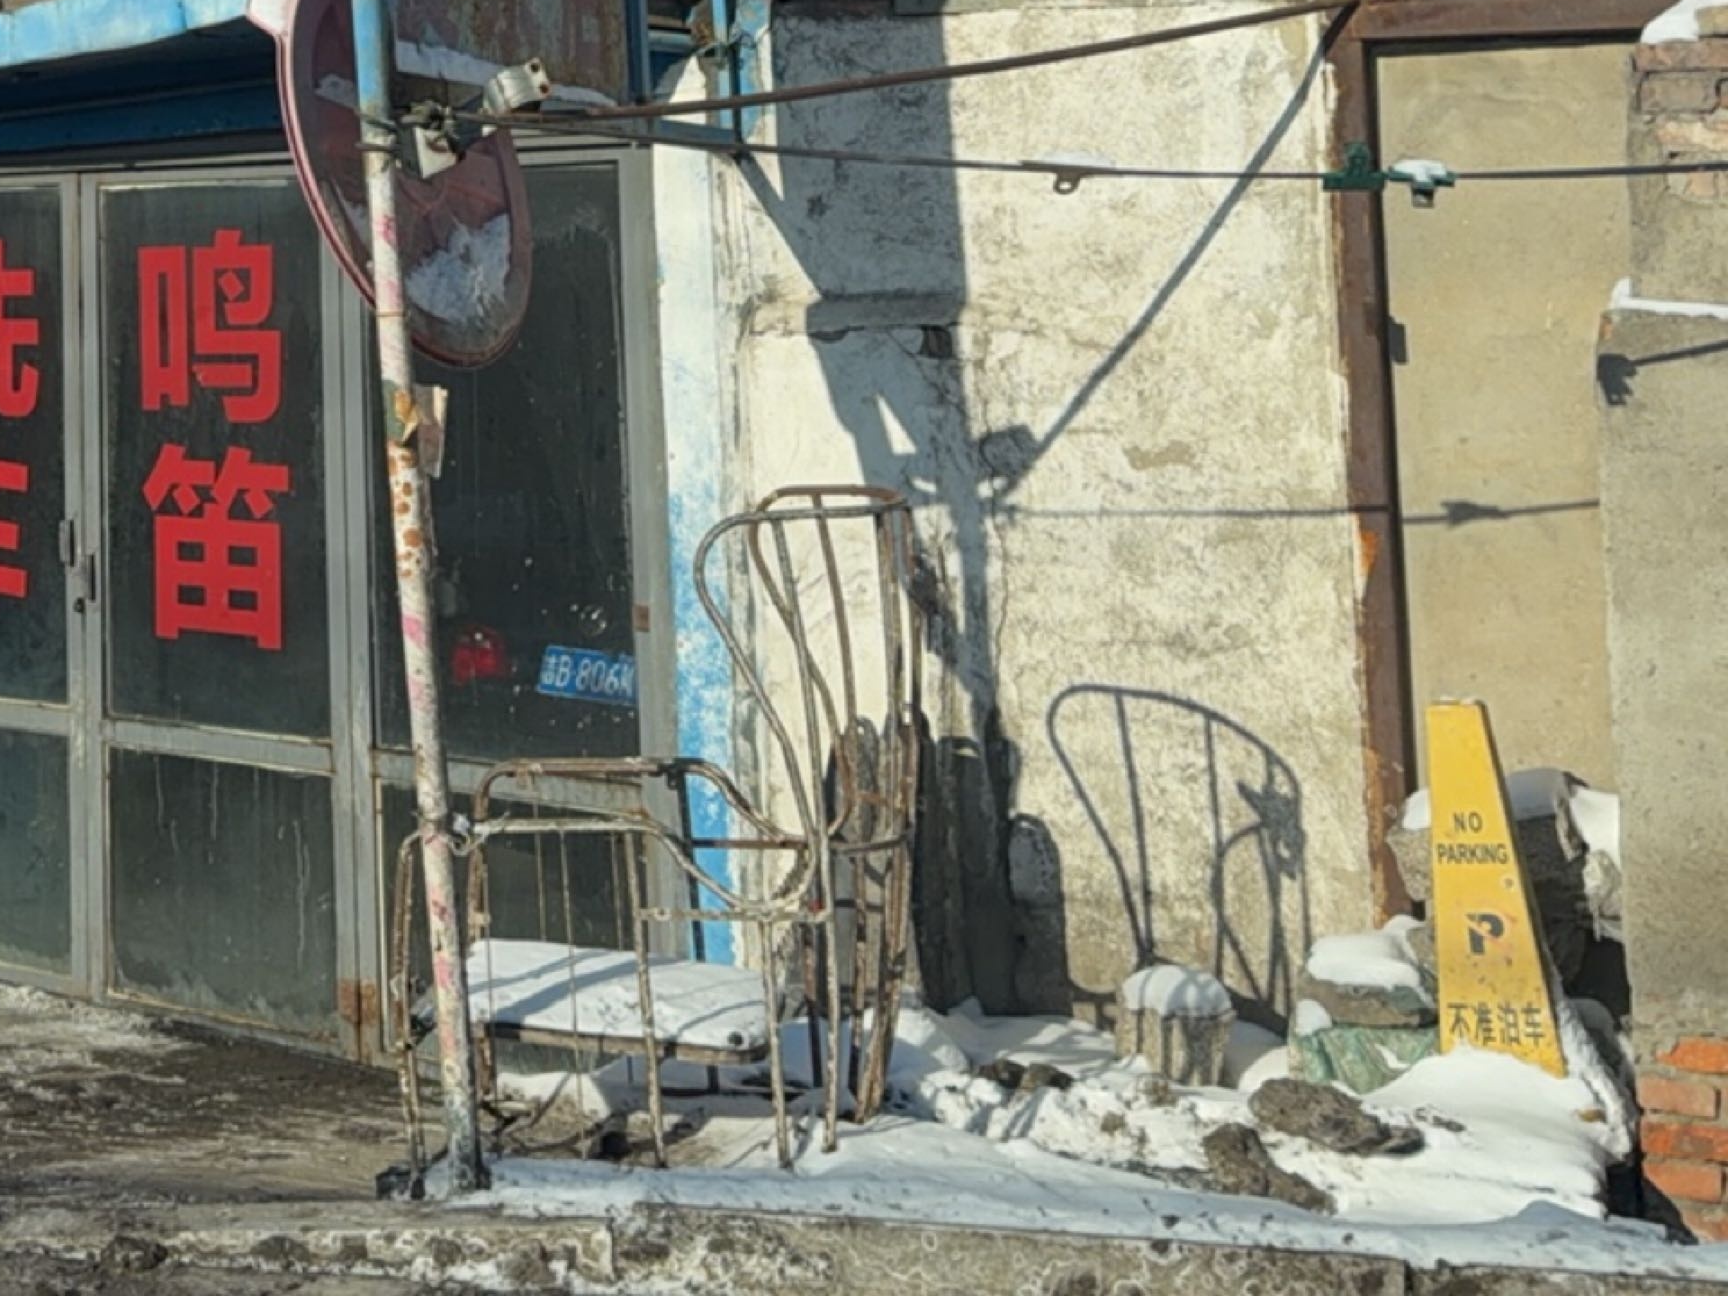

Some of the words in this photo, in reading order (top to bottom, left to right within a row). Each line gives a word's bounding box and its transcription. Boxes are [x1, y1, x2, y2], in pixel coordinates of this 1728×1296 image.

[136, 227, 290, 651] 鸣笛
[1452, 811, 1483, 835] NO
[1437, 842, 1510, 866] PARKING
[1446, 1001, 1547, 1048] 不准泊车
